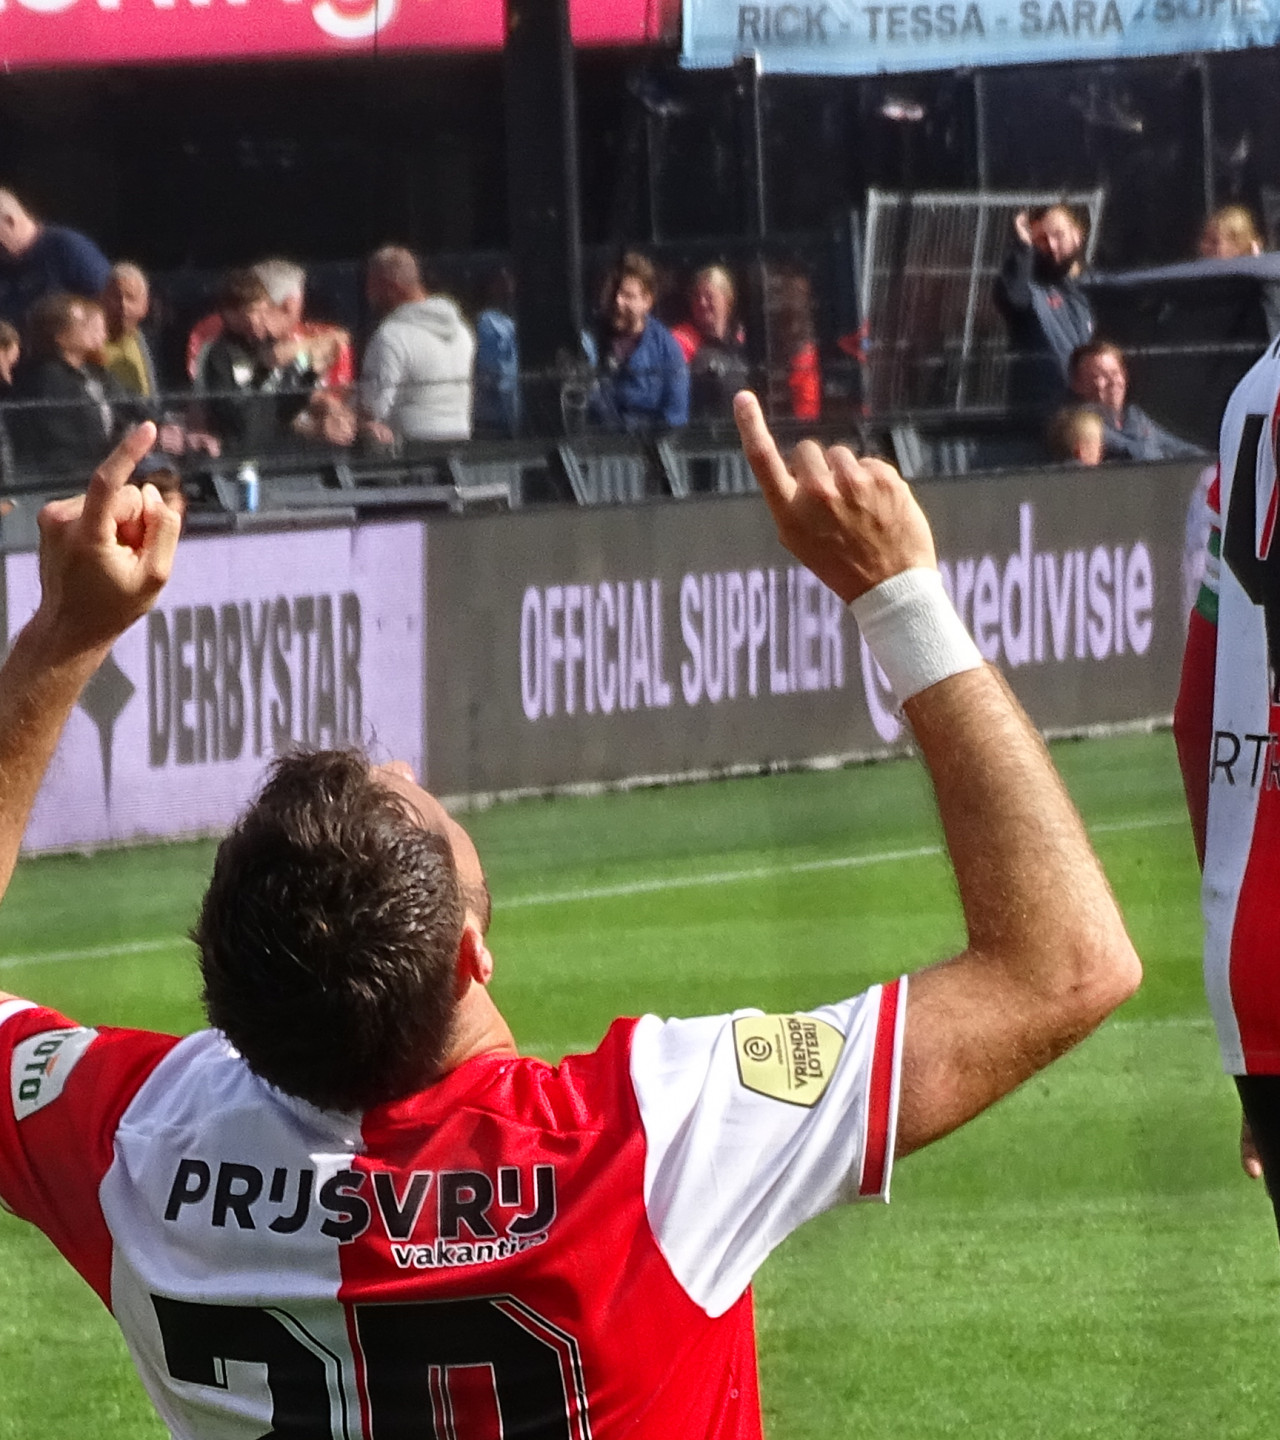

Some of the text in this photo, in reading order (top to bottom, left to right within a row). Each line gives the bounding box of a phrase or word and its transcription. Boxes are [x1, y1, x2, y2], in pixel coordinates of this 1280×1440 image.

[737, 4, 828, 44] RICK
[863, 2, 985, 42] TESSA
[1021, 0, 1125, 38] SARA
[147, 589, 363, 769] DERBYSTAR
[521, 501, 1154, 722] OFFICIAL SUPPLIER redivisie
